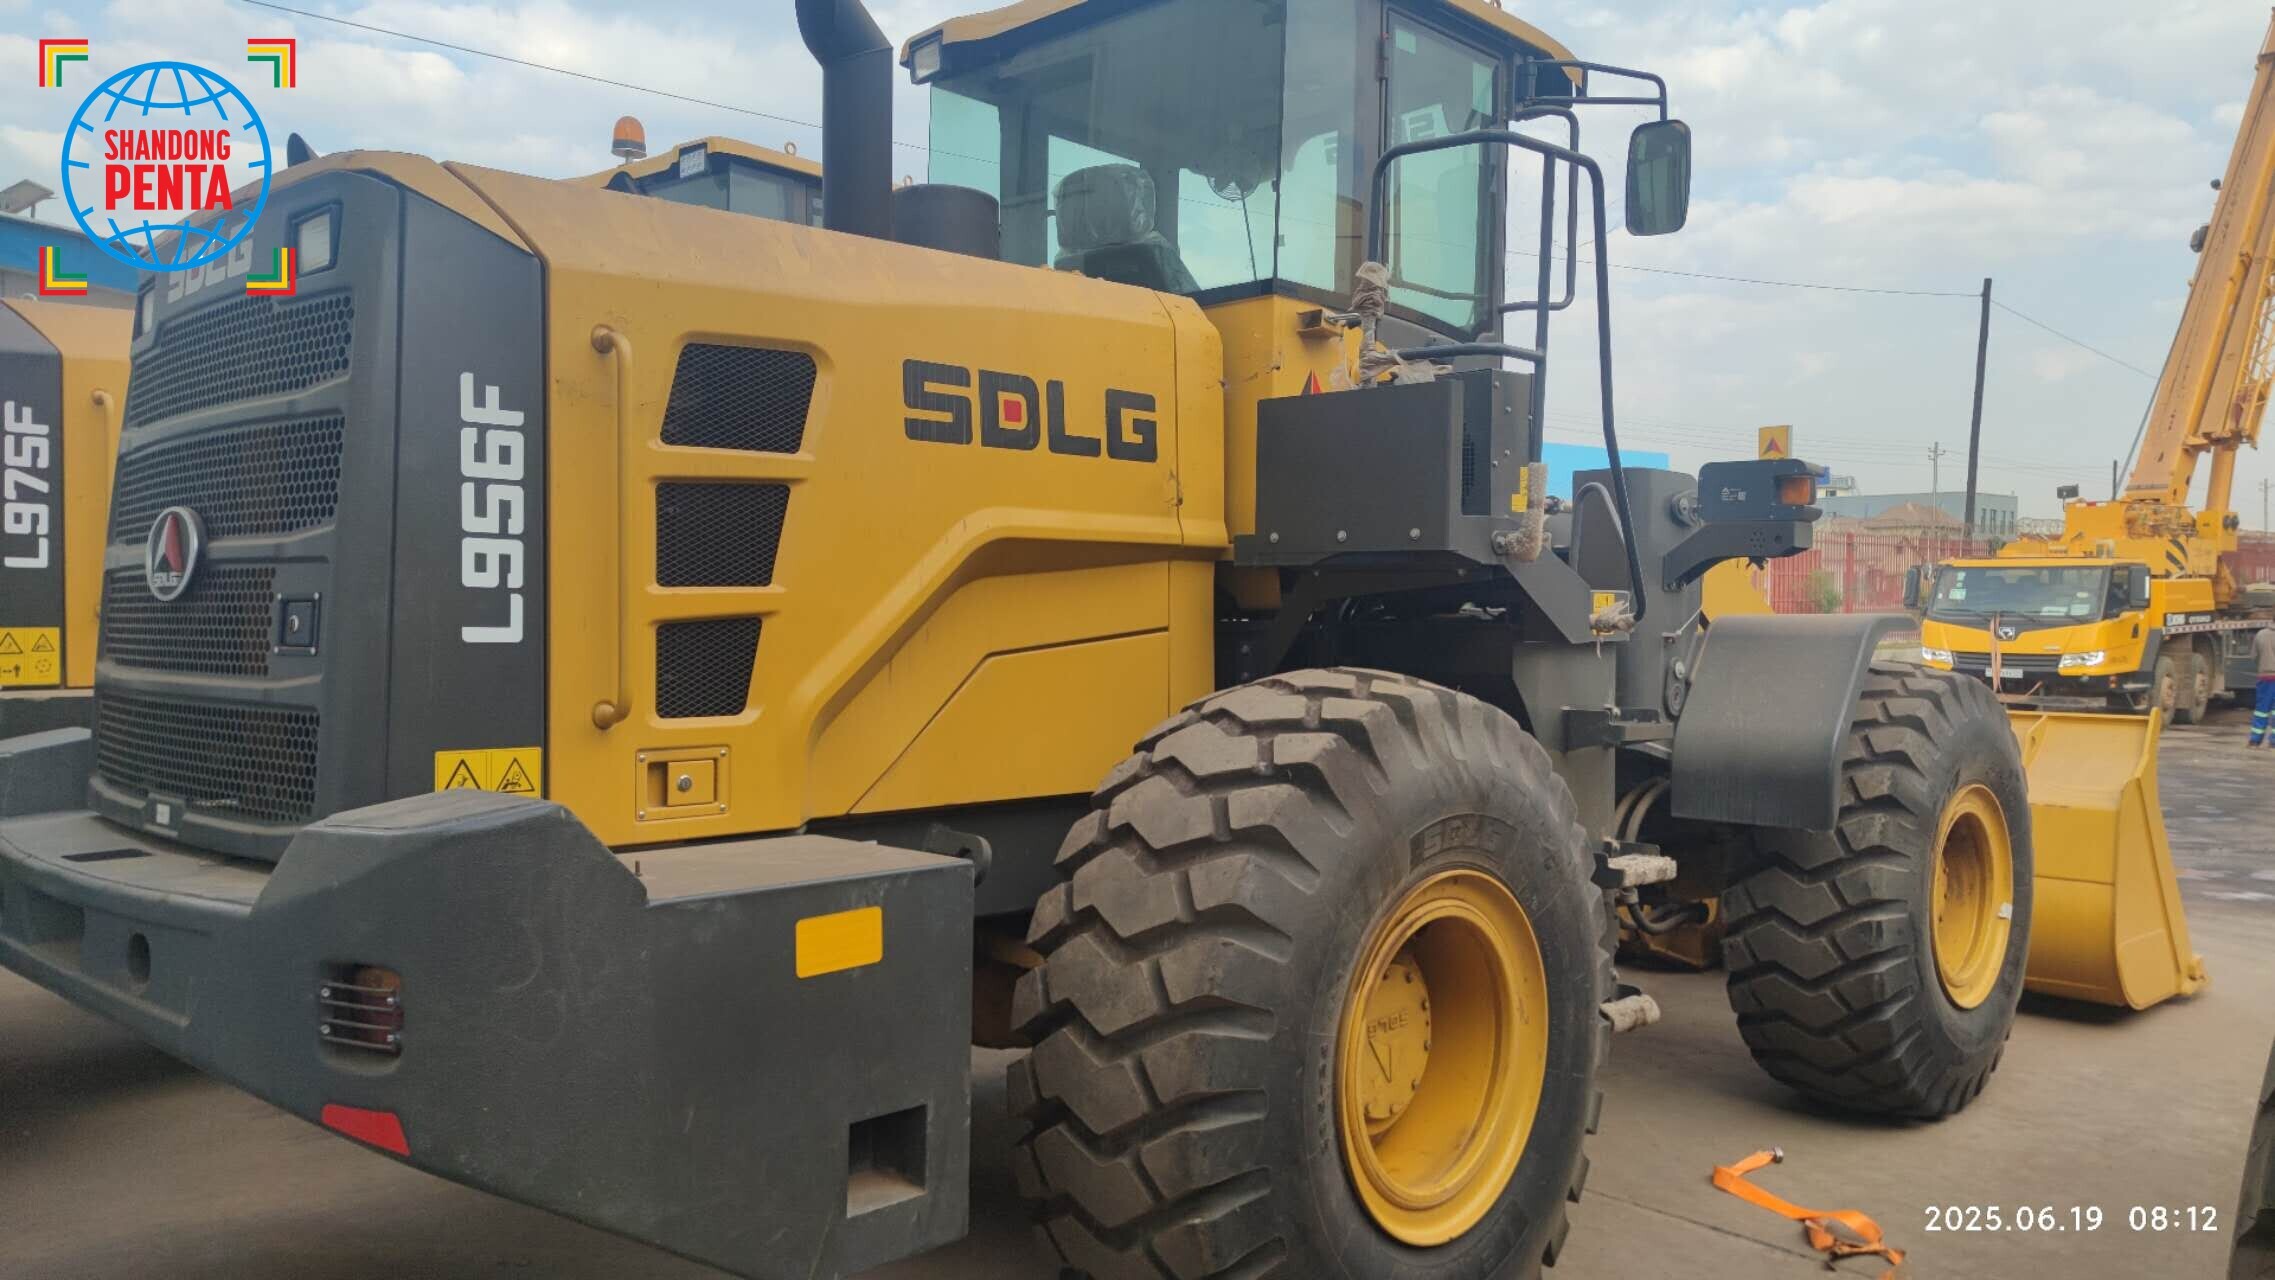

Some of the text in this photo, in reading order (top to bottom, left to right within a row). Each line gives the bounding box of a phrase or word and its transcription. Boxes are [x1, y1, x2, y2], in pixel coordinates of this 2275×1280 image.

[4, 400, 49, 568] L975F
[902, 358, 1158, 463] SDLG
[460, 372, 525, 643] L956F
